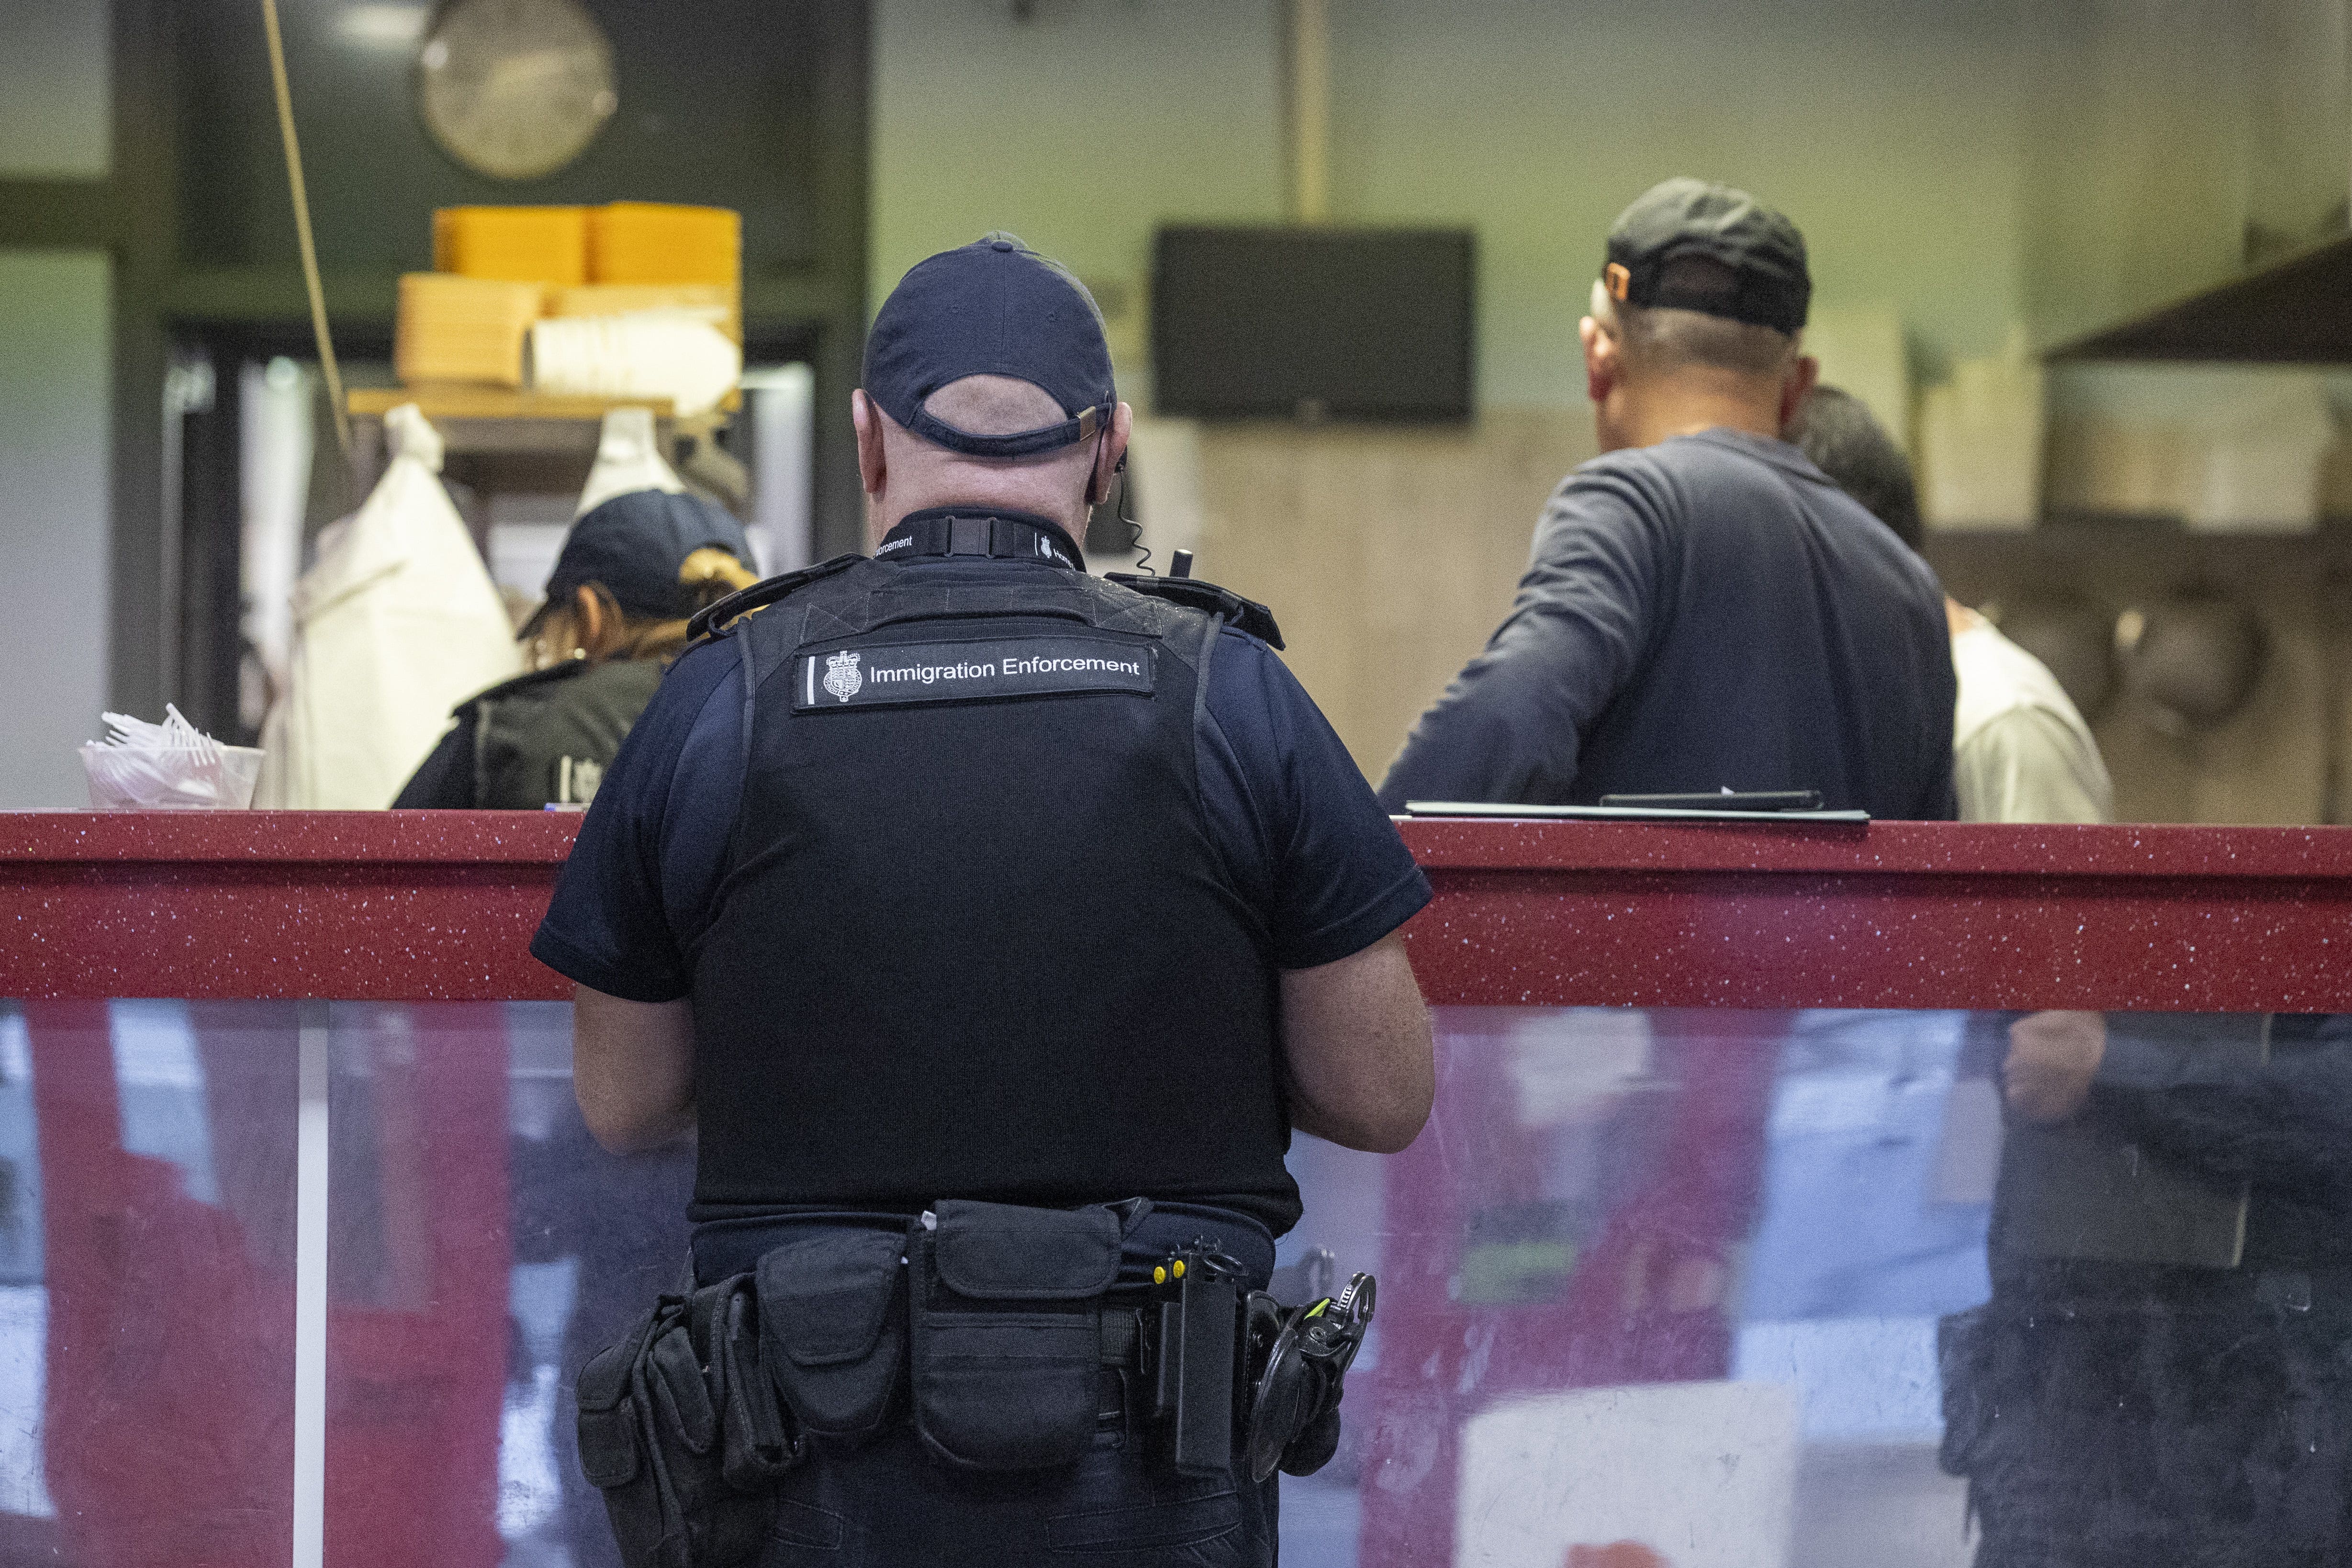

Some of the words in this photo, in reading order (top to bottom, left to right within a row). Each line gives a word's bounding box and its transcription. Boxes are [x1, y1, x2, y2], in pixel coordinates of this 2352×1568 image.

[875, 535, 912, 557] nforcement
[871, 662, 995, 684] Immigration
[1003, 656, 1140, 675] Enforcement
